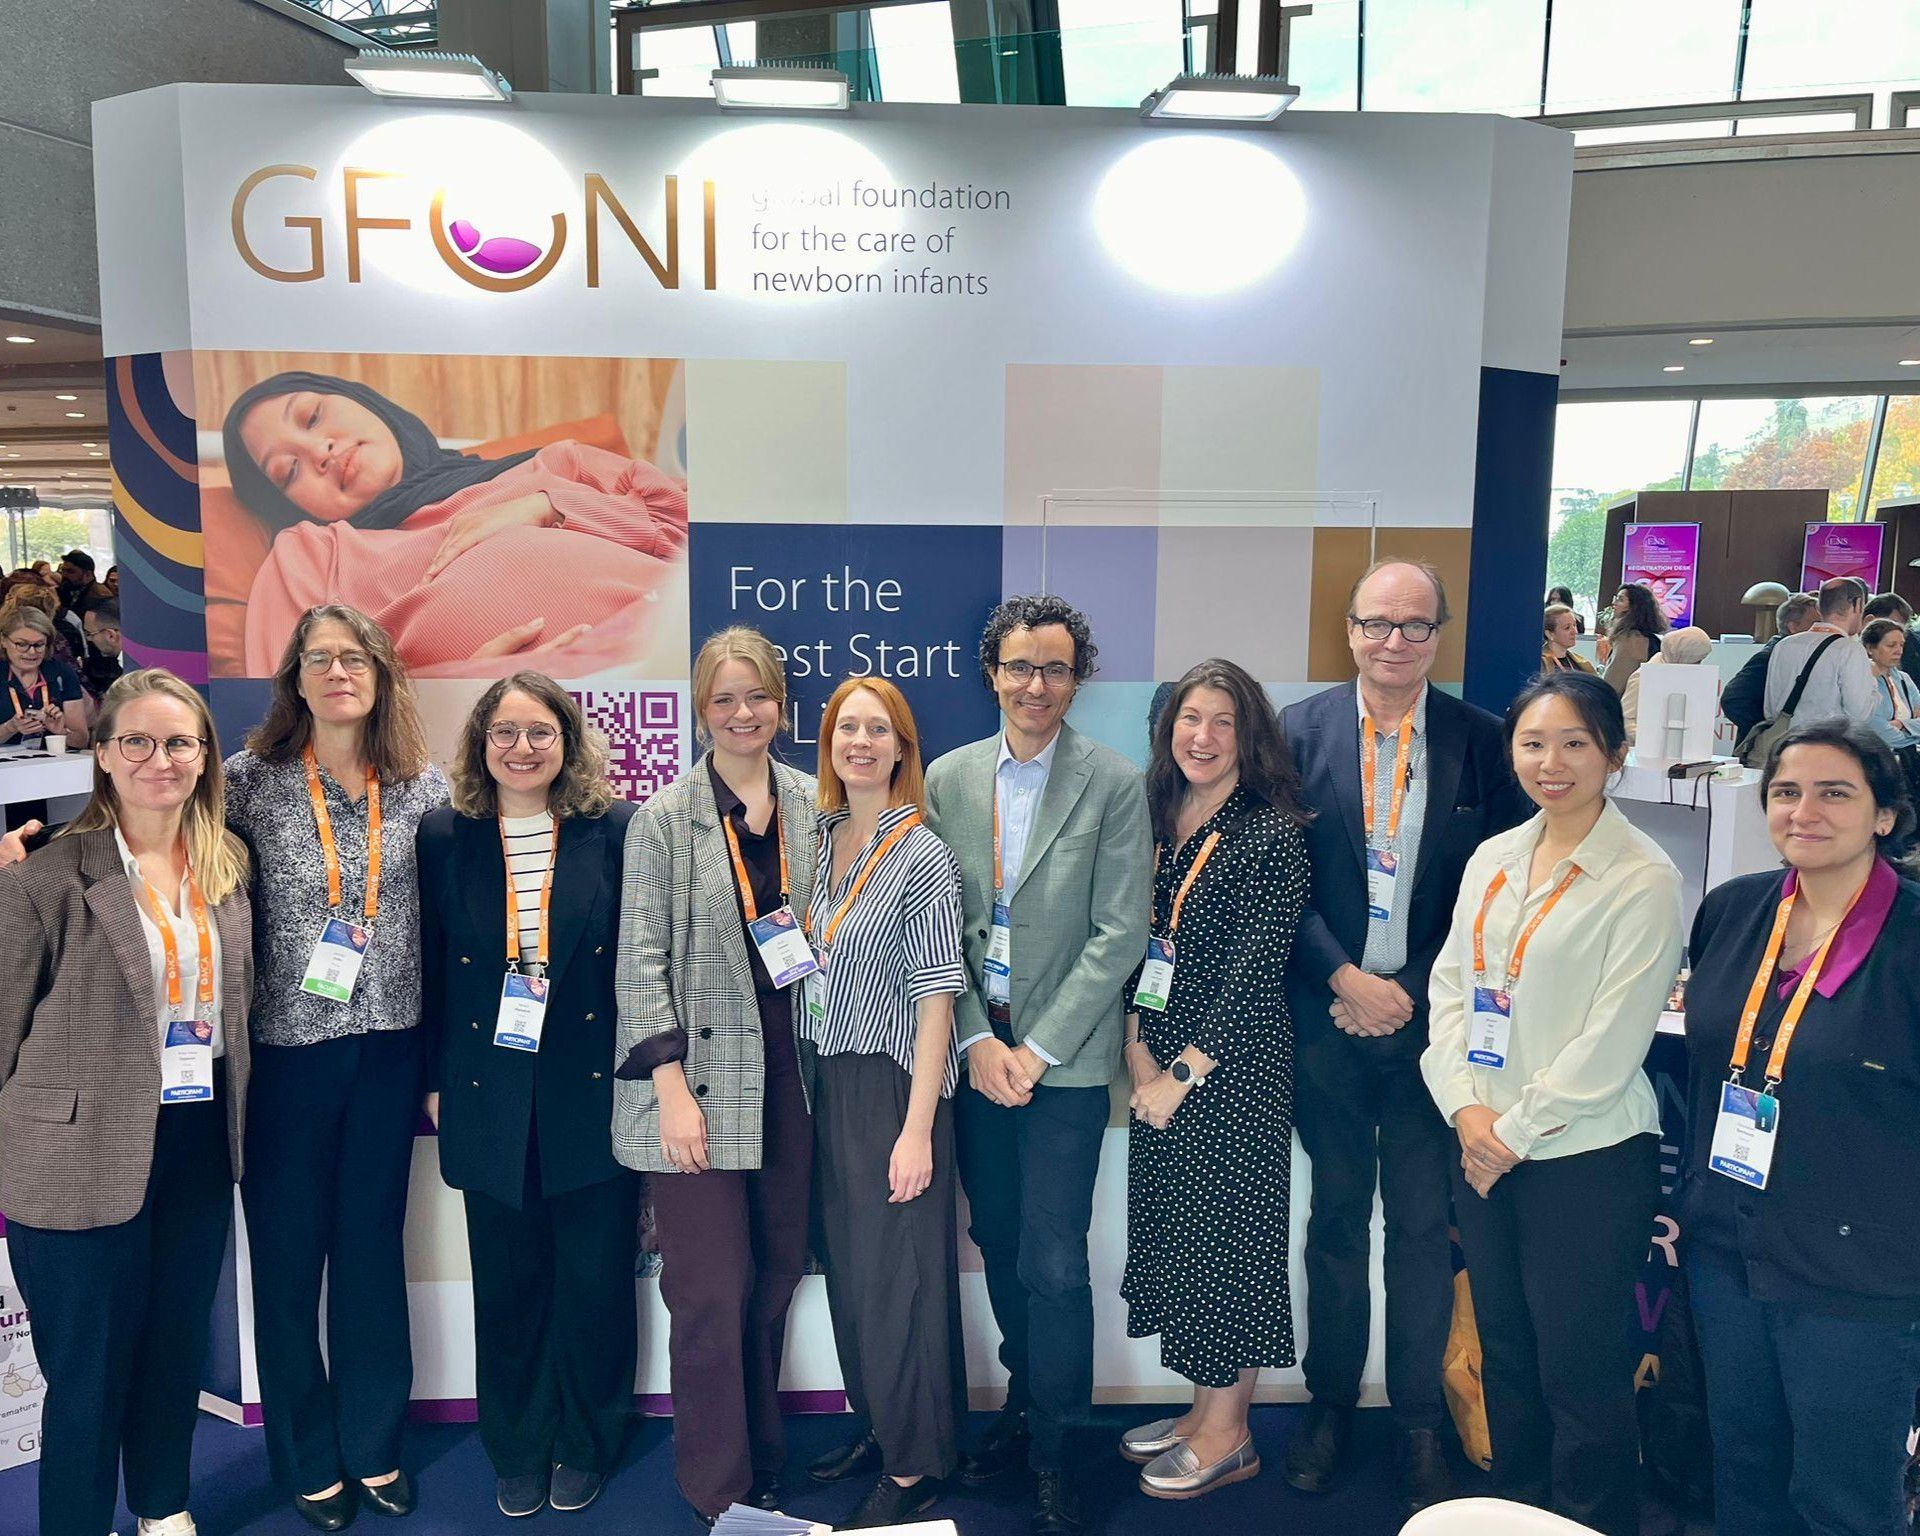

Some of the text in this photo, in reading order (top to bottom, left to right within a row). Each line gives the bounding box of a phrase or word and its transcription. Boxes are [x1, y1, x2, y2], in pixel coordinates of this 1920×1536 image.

[752, 180, 1011, 213] gal foundation
[232, 162, 717, 293] GFONI
[752, 223, 955, 254] for the care of
[753, 266, 988, 296] newborn infants
[731, 565, 902, 612] For the
[1635, 578, 1686, 600] -Z
[775, 633, 961, 678] est Start
[793, 701, 826, 744] L
[170, 1088, 203, 1097] PARTICIPANT
[1719, 1159, 1757, 1178] PARTICIPANT
[2, 1330, 30, 1343] 17 No
[0, 1402, 40, 1418] emature.
